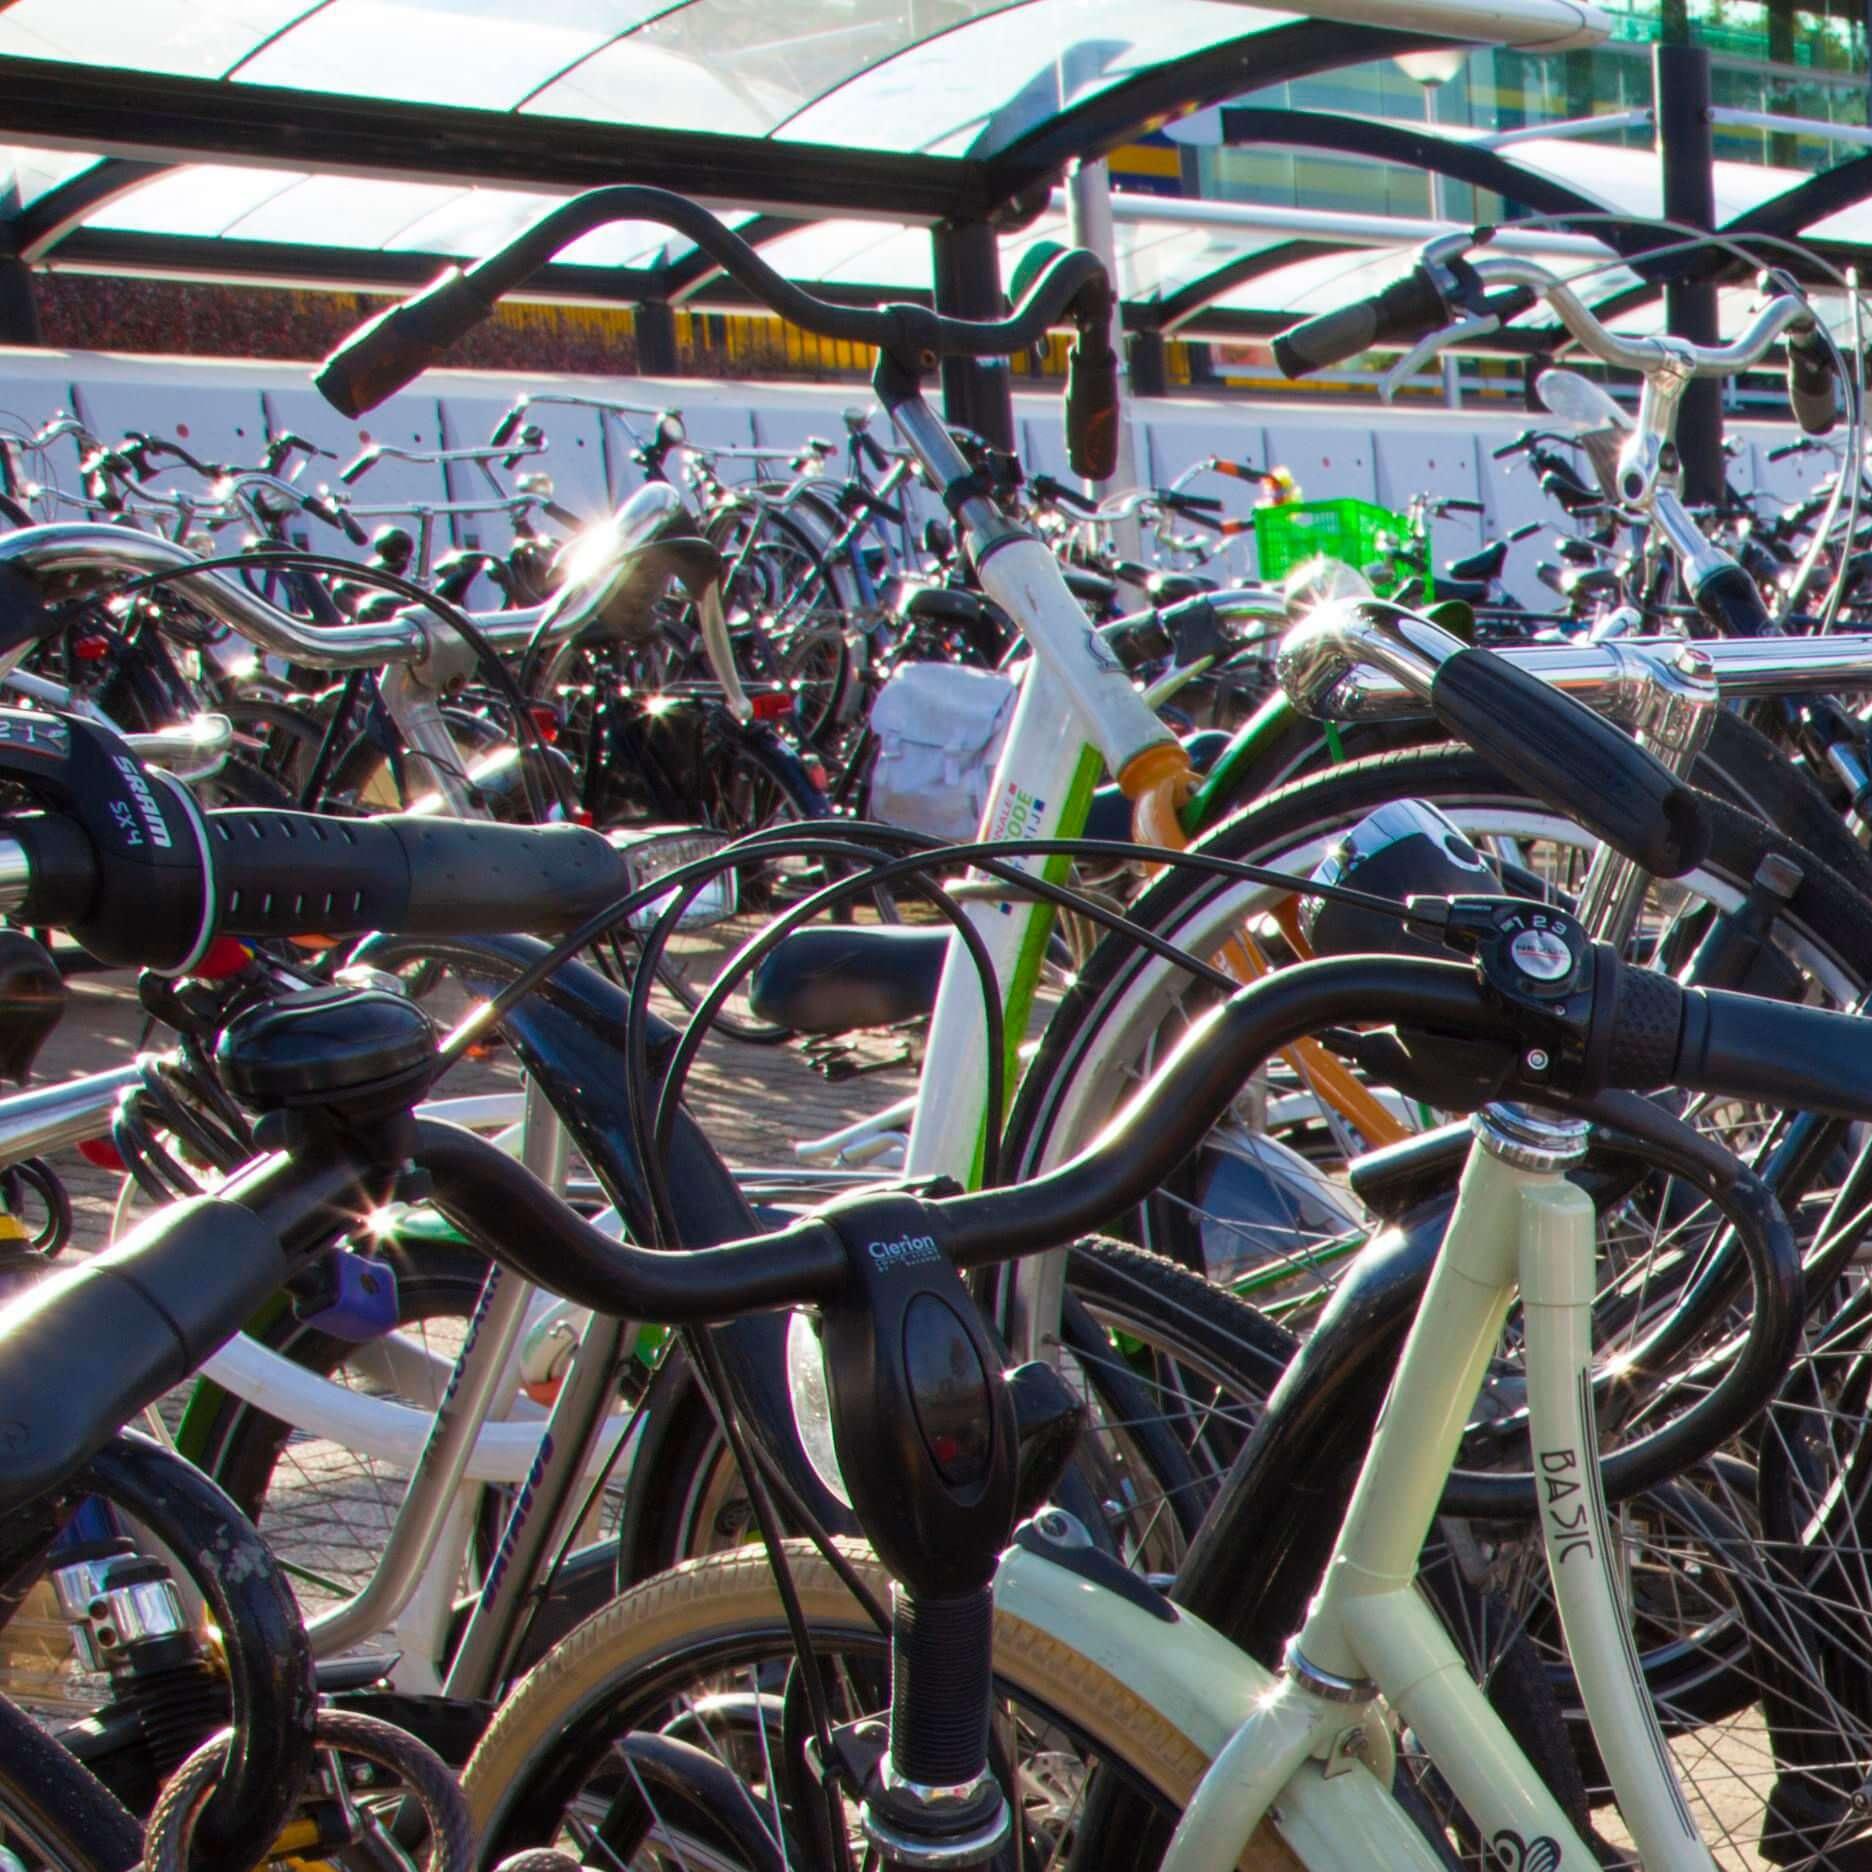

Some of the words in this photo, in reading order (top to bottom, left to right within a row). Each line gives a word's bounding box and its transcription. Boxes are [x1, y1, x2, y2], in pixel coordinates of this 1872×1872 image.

[109, 800, 145, 846] SX4
[112, 755, 173, 849] SRAM
[1532, 914, 1548, 929] 2
[1551, 920, 1568, 935] 3
[868, 1233, 937, 1258] Clerion
[1540, 1449, 1595, 1565] BASIC
